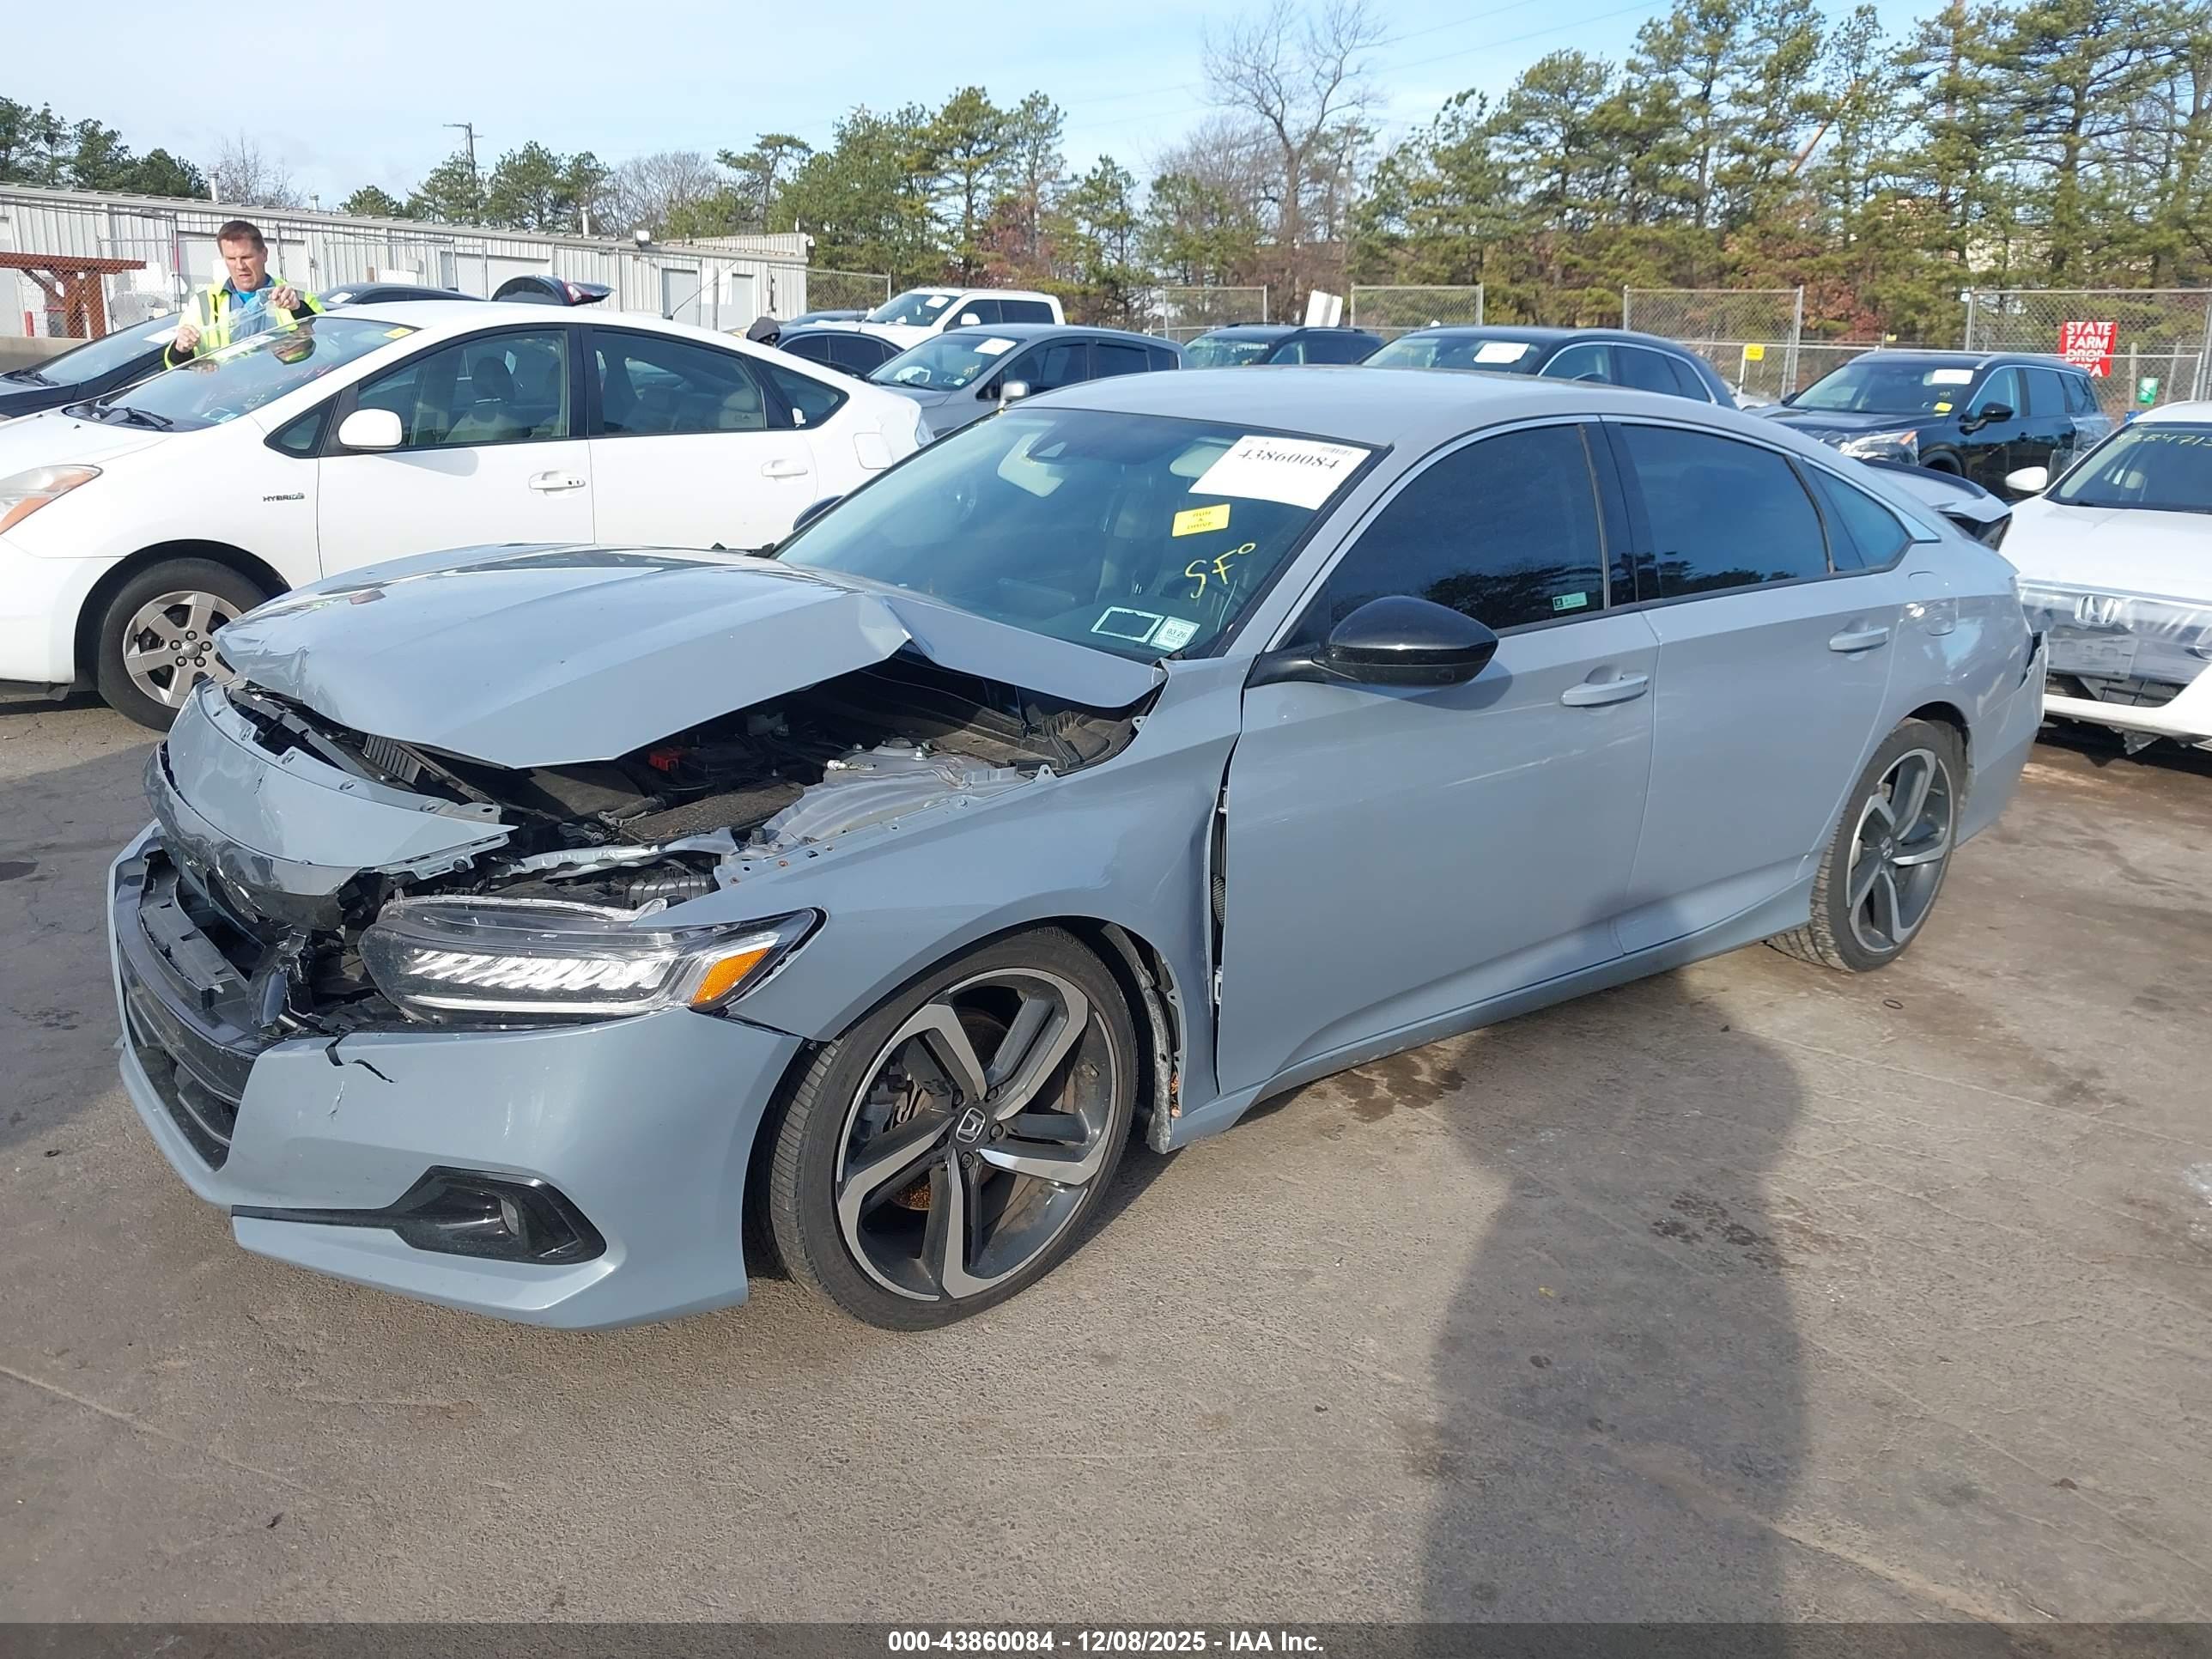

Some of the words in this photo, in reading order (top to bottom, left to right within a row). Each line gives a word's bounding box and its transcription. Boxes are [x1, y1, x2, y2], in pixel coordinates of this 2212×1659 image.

[2066, 321, 2113, 336] STATE
[2066, 335, 2110, 349] FARM
[2065, 349, 2106, 362] DROP
[1237, 448, 1340, 470] 43860084
